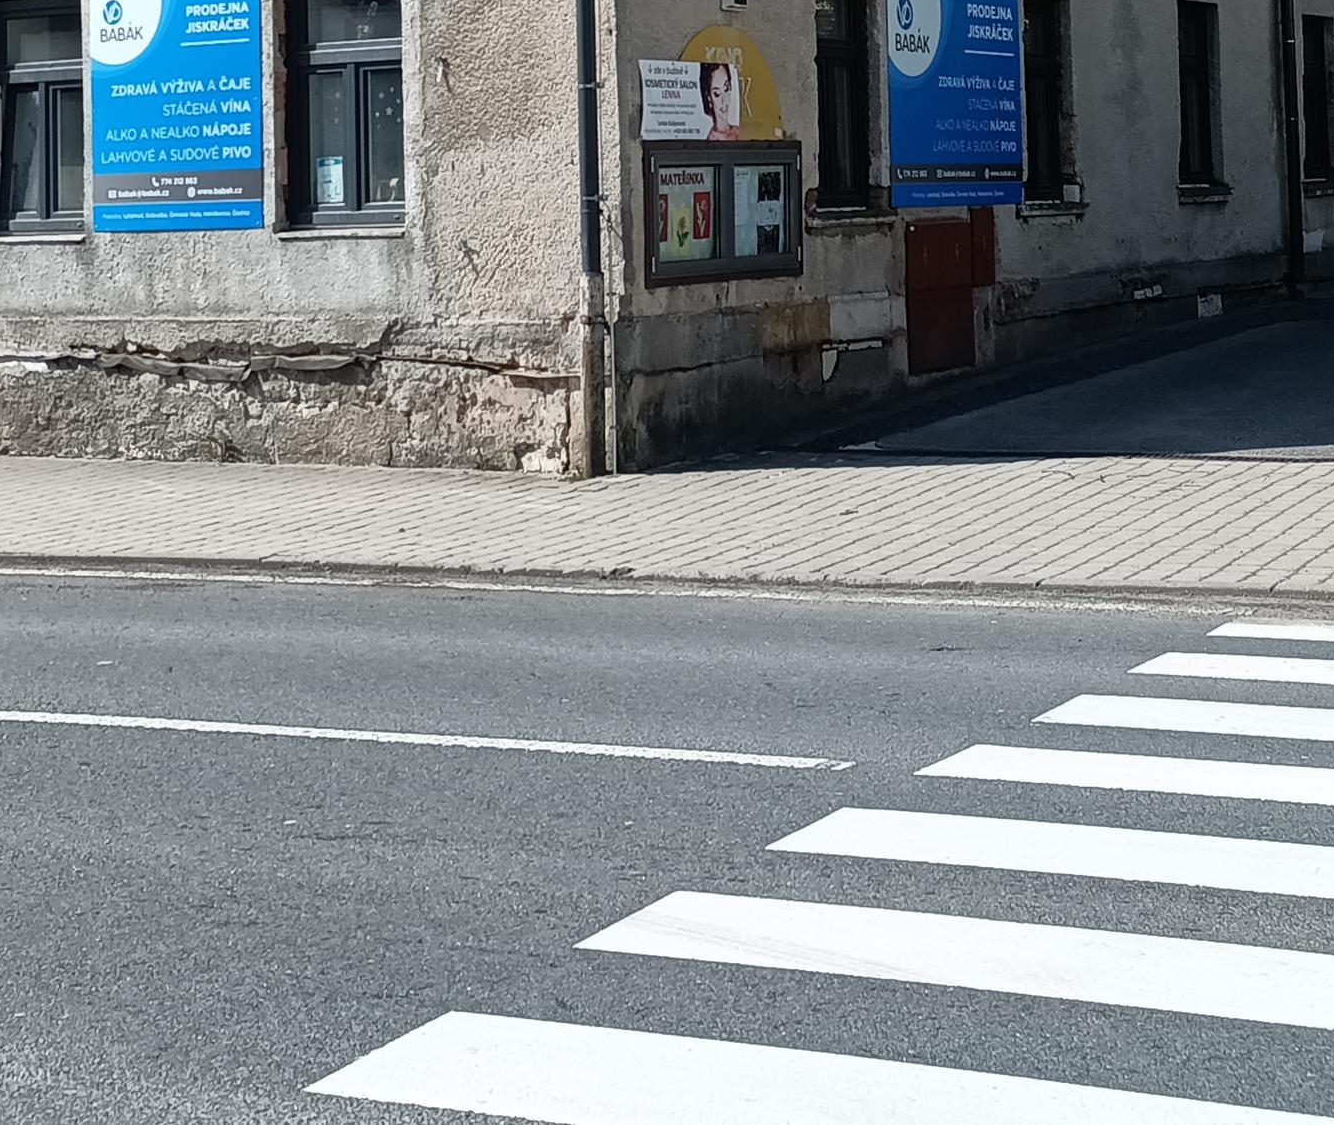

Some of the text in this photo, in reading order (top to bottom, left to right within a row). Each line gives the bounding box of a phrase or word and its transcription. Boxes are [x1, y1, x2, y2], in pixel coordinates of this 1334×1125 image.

[186, 1, 249, 17] PRODEJNA
[967, 3, 1013, 21] PRODEJNA
[100, 22, 143, 43] BABÁK
[185, 17, 249, 34] JISKRÁČEK
[968, 24, 1014, 42] JISKRÁČEK
[895, 29, 930, 53] BABÁK
[111, 76, 251, 97] ZDRAVÁ VÝŽIVA A ČAJE
[679, 80, 698, 90] SALON
[938, 75, 966, 88] ZDRAVÁ
[967, 75, 991, 90] VÝŽIVA
[998, 76, 1015, 91] ČAJE
[163, 98, 251, 117] STÁČENÁ VÍNA
[999, 97, 1016, 111] VÍNA
[105, 122, 251, 141] ALKO A NEALKO NÁPOJE
[990, 118, 1017, 132] NÁPOJE
[101, 145, 251, 164] LAHVOVÉ A SUDOVÉ PIVO
[1001, 141, 1017, 152] PIVO
[660, 170, 705, 186] MATEŘINKA
